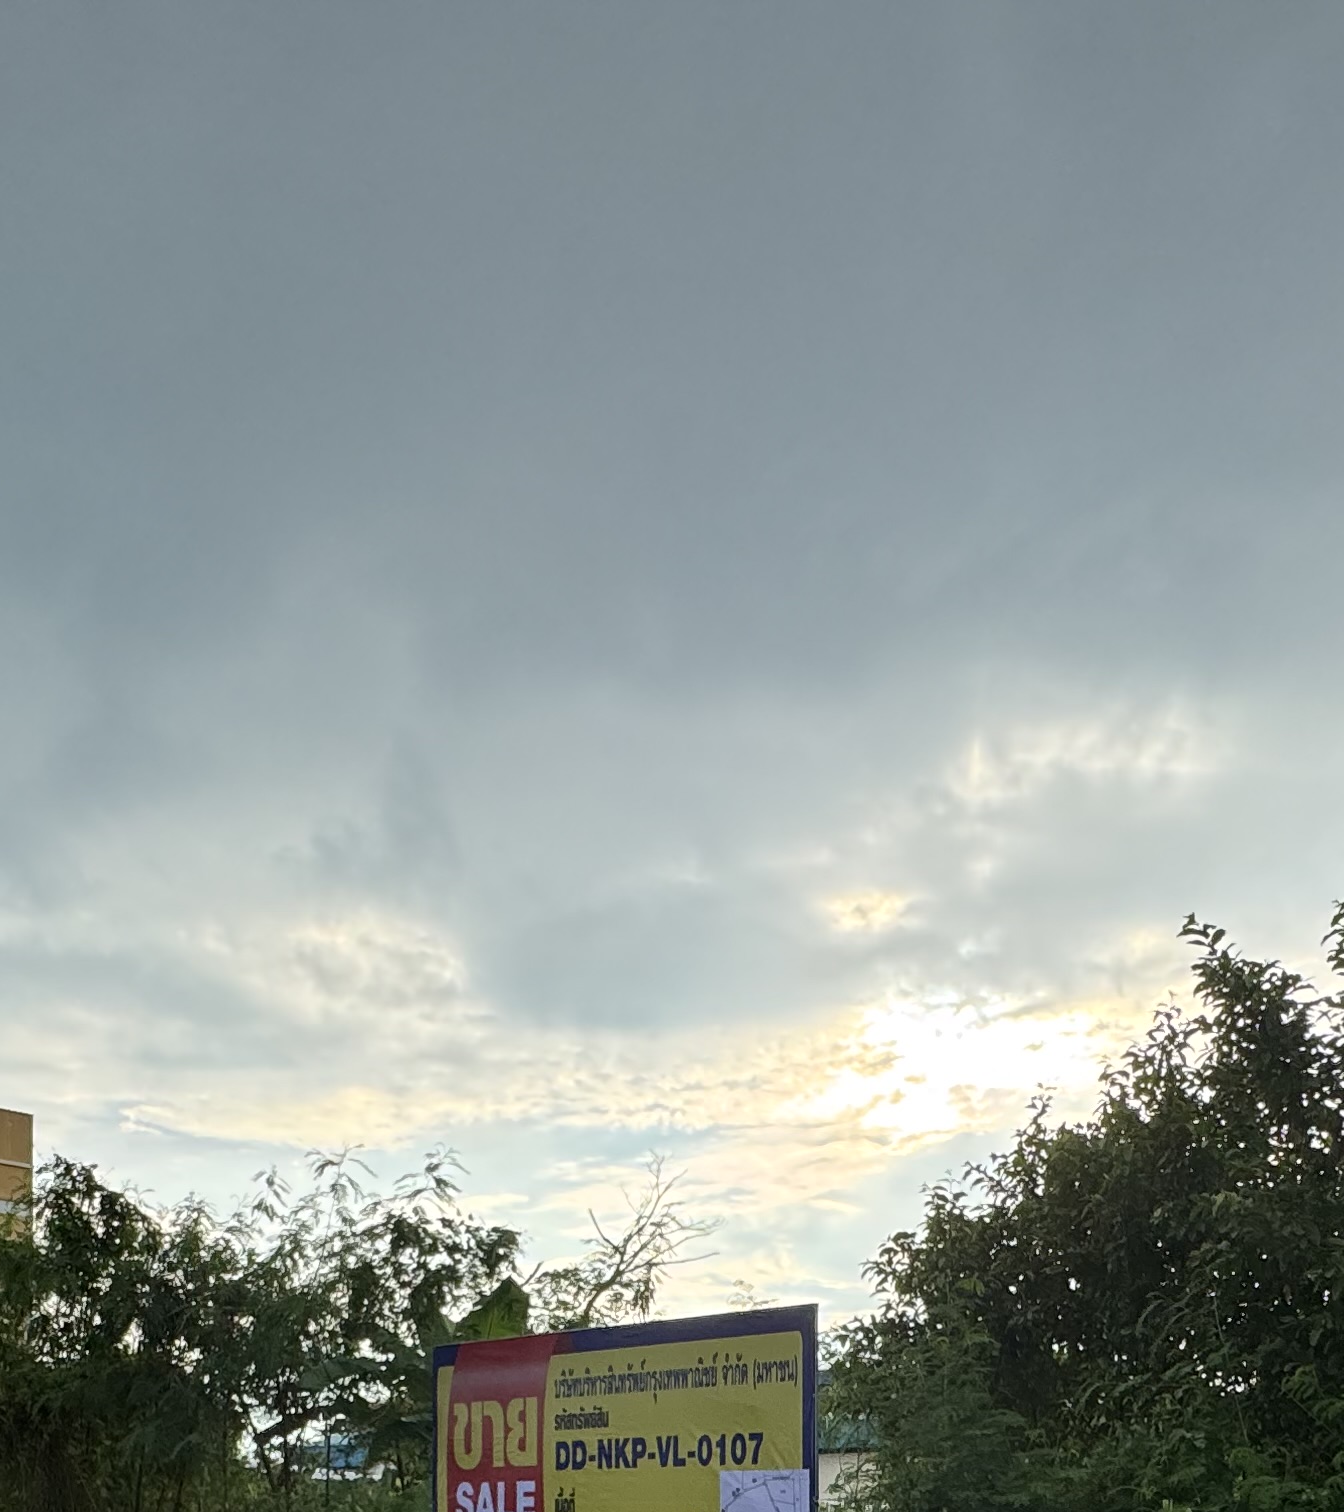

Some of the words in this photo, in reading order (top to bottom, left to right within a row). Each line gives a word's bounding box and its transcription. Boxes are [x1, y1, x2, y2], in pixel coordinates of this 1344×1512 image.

[722, 1352, 748, 1386] จำกัด
[753, 1354, 798, 1390] (มหาชน)
[453, 1396, 538, 1470] ขาย
[555, 1432, 764, 1471] DD-NKP-VL-0107
